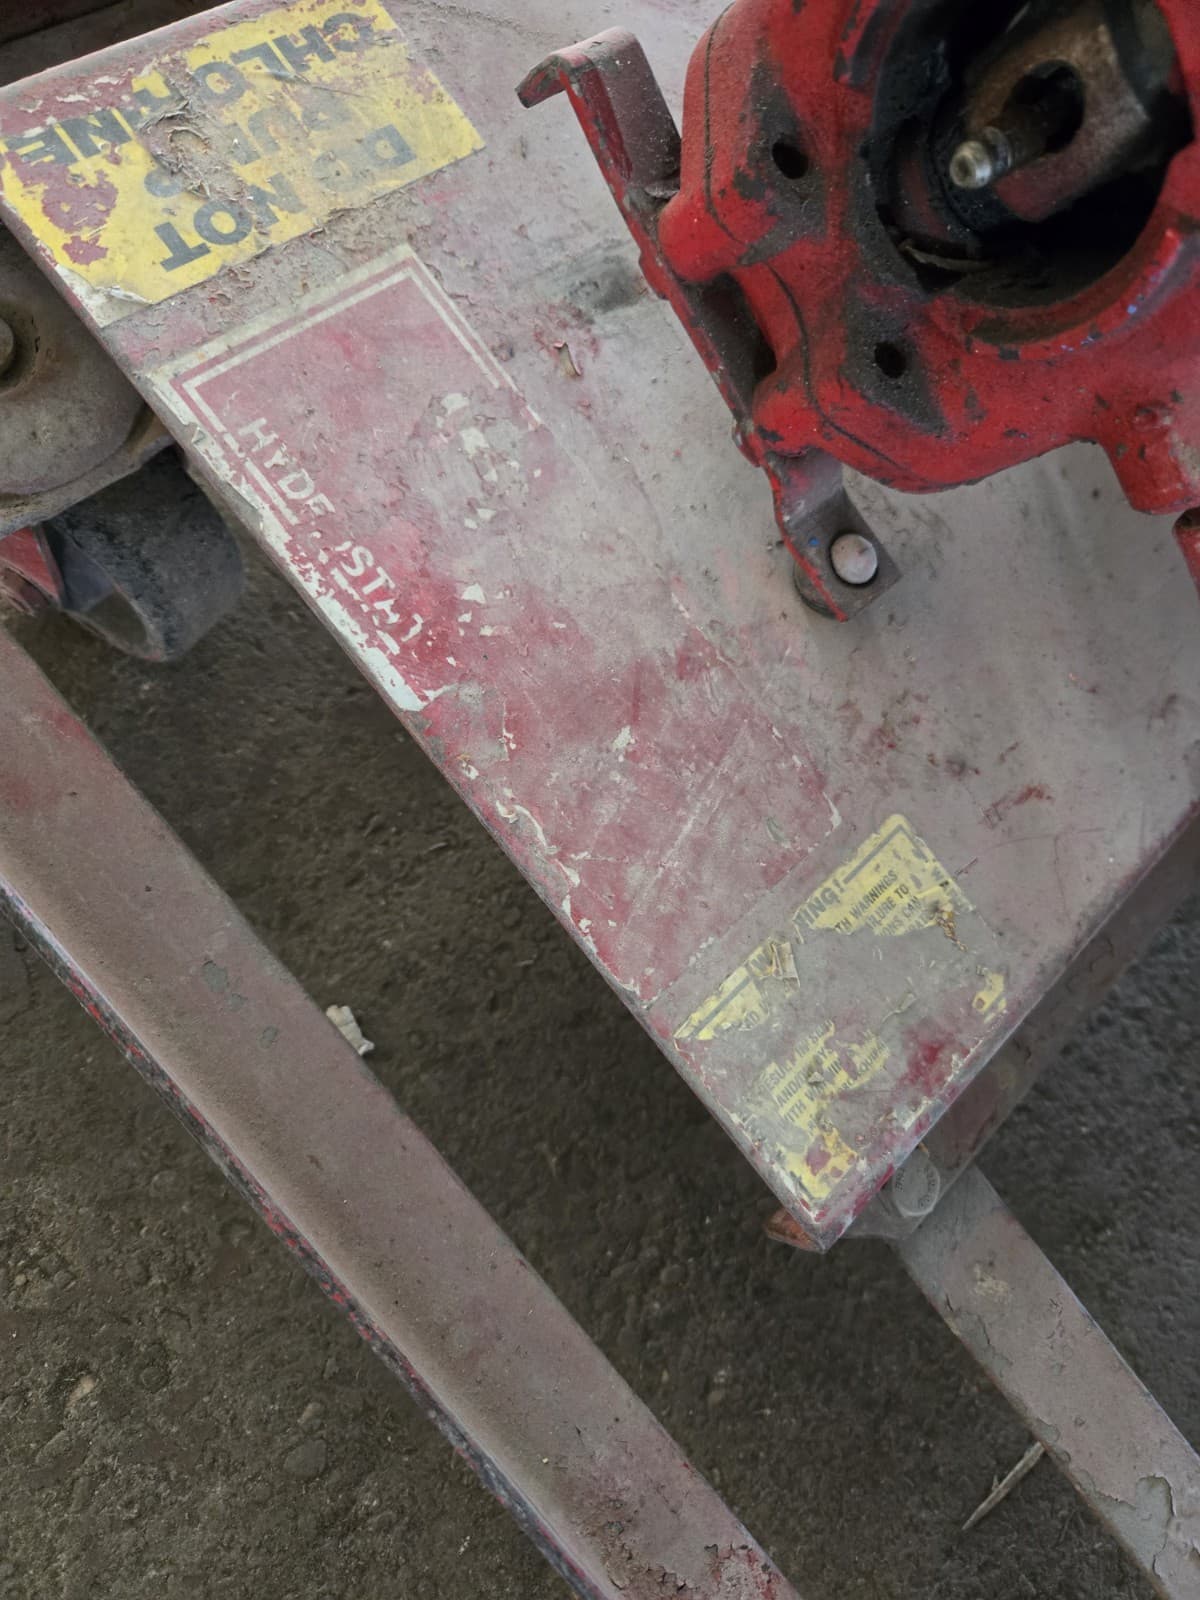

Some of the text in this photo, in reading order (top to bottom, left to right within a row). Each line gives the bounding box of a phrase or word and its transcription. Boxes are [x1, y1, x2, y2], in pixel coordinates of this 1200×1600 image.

[153, 174, 306, 272] NOT
[850, 869, 898, 920] WARNINGS
[894, 883, 909, 899] TO
